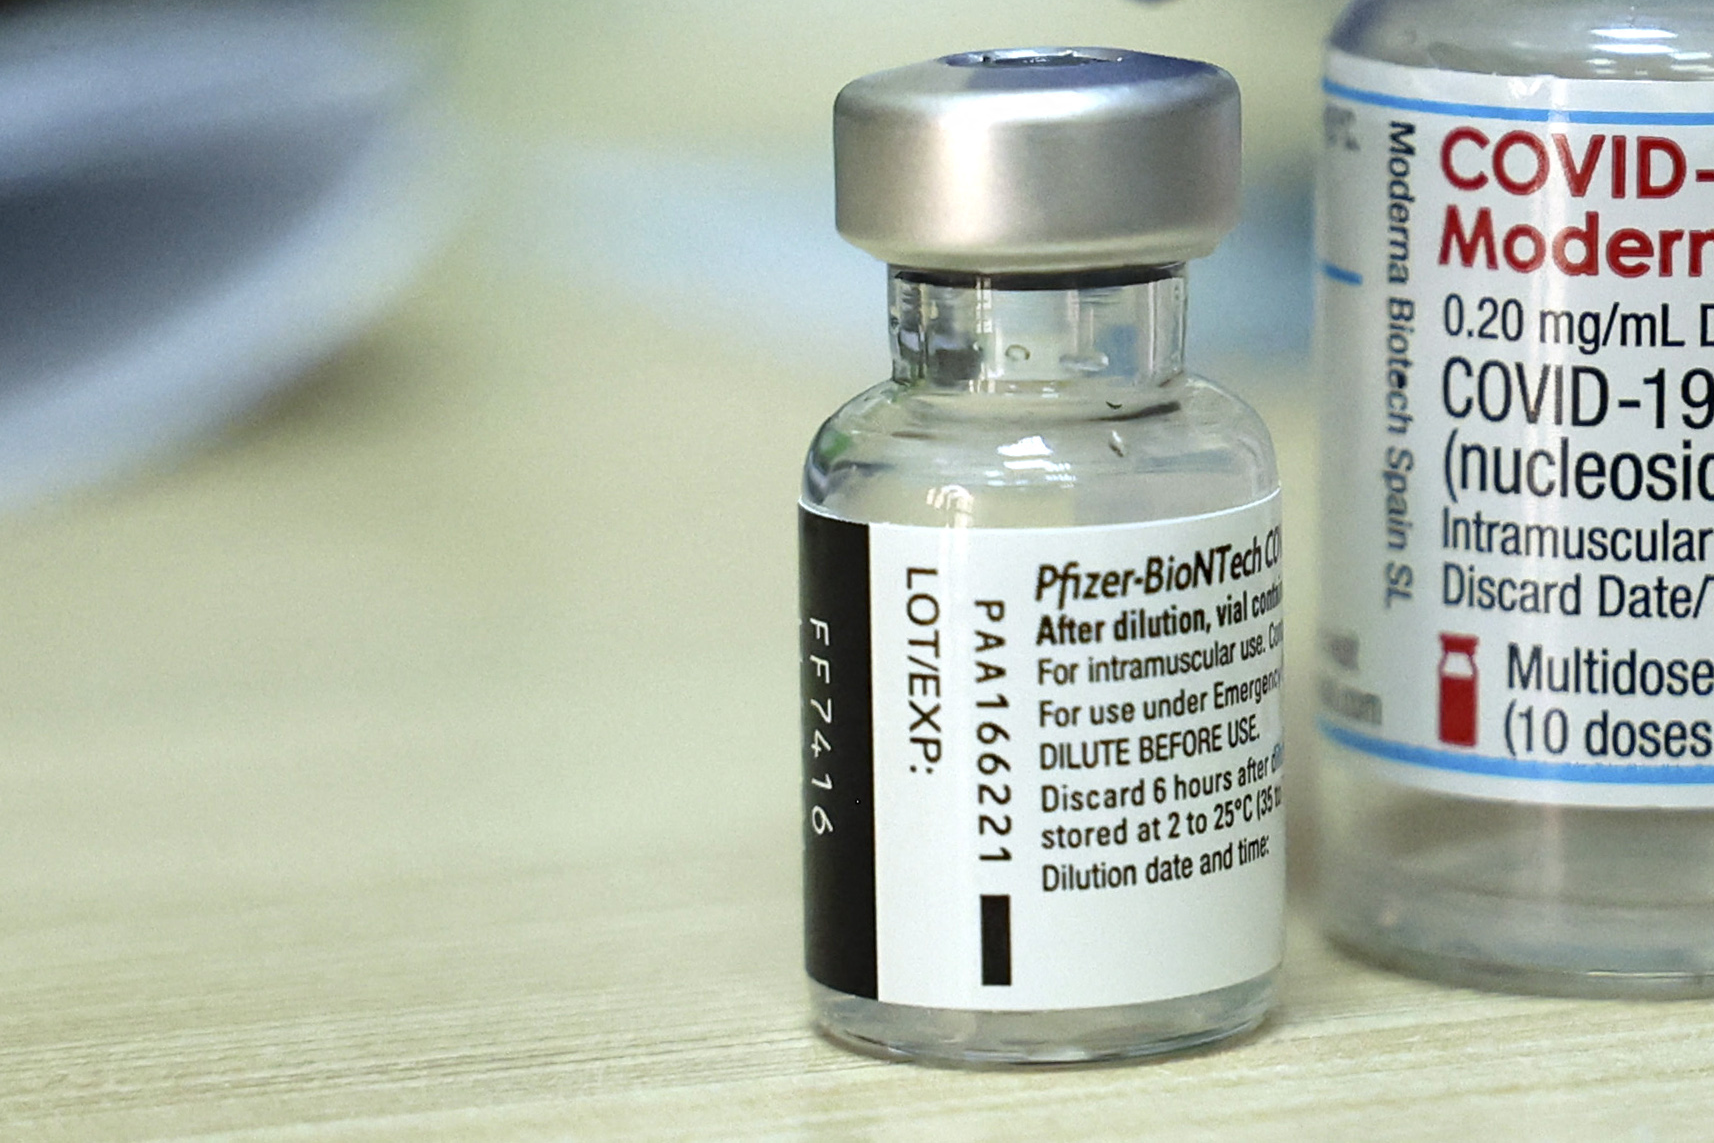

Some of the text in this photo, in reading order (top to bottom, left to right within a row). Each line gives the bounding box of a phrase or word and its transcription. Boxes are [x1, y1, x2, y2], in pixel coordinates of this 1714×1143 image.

[1387, 120, 1416, 284] Moderna
[1443, 294, 1524, 343] 0.20
[1540, 302, 1686, 356] mg/mL
[1386, 296, 1415, 435] Biotech
[1382, 445, 1414, 552] Spain
[1440, 507, 1714, 562] Intramuscular
[1035, 536, 1262, 610] Pfizer-BioNTech
[1440, 563, 1581, 617] Discard
[1036, 614, 1105, 646] After
[1113, 605, 1211, 642] dilution,
[1216, 590, 1247, 627] vial
[906, 567, 942, 774] LOT/EXP:
[1038, 658, 1079, 685] For
[1088, 641, 1236, 683] intramuscular
[1240, 634, 1266, 662] use.
[1508, 643, 1714, 696] Multidose
[809, 616, 834, 836] FF7416
[973, 599, 1012, 862] PAA166221
[1039, 700, 1082, 728] For
[1090, 702, 1135, 725] use
[1143, 689, 1208, 718] under
[1503, 699, 1568, 757] (10
[1585, 711, 1712, 759] doses
[1040, 714, 1260, 770] DILUTE BEFORE USE.
[1041, 778, 1145, 813] Discard
[1153, 777, 1167, 804] 6
[1174, 770, 1232, 801] hours
[1237, 756, 1269, 787] after
[1041, 818, 1128, 850] stored
[1137, 817, 1161, 843] at
[1168, 812, 1181, 839] 2
[1185, 811, 1208, 837] to
[1042, 834, 1270, 892] Dilution date and time:
